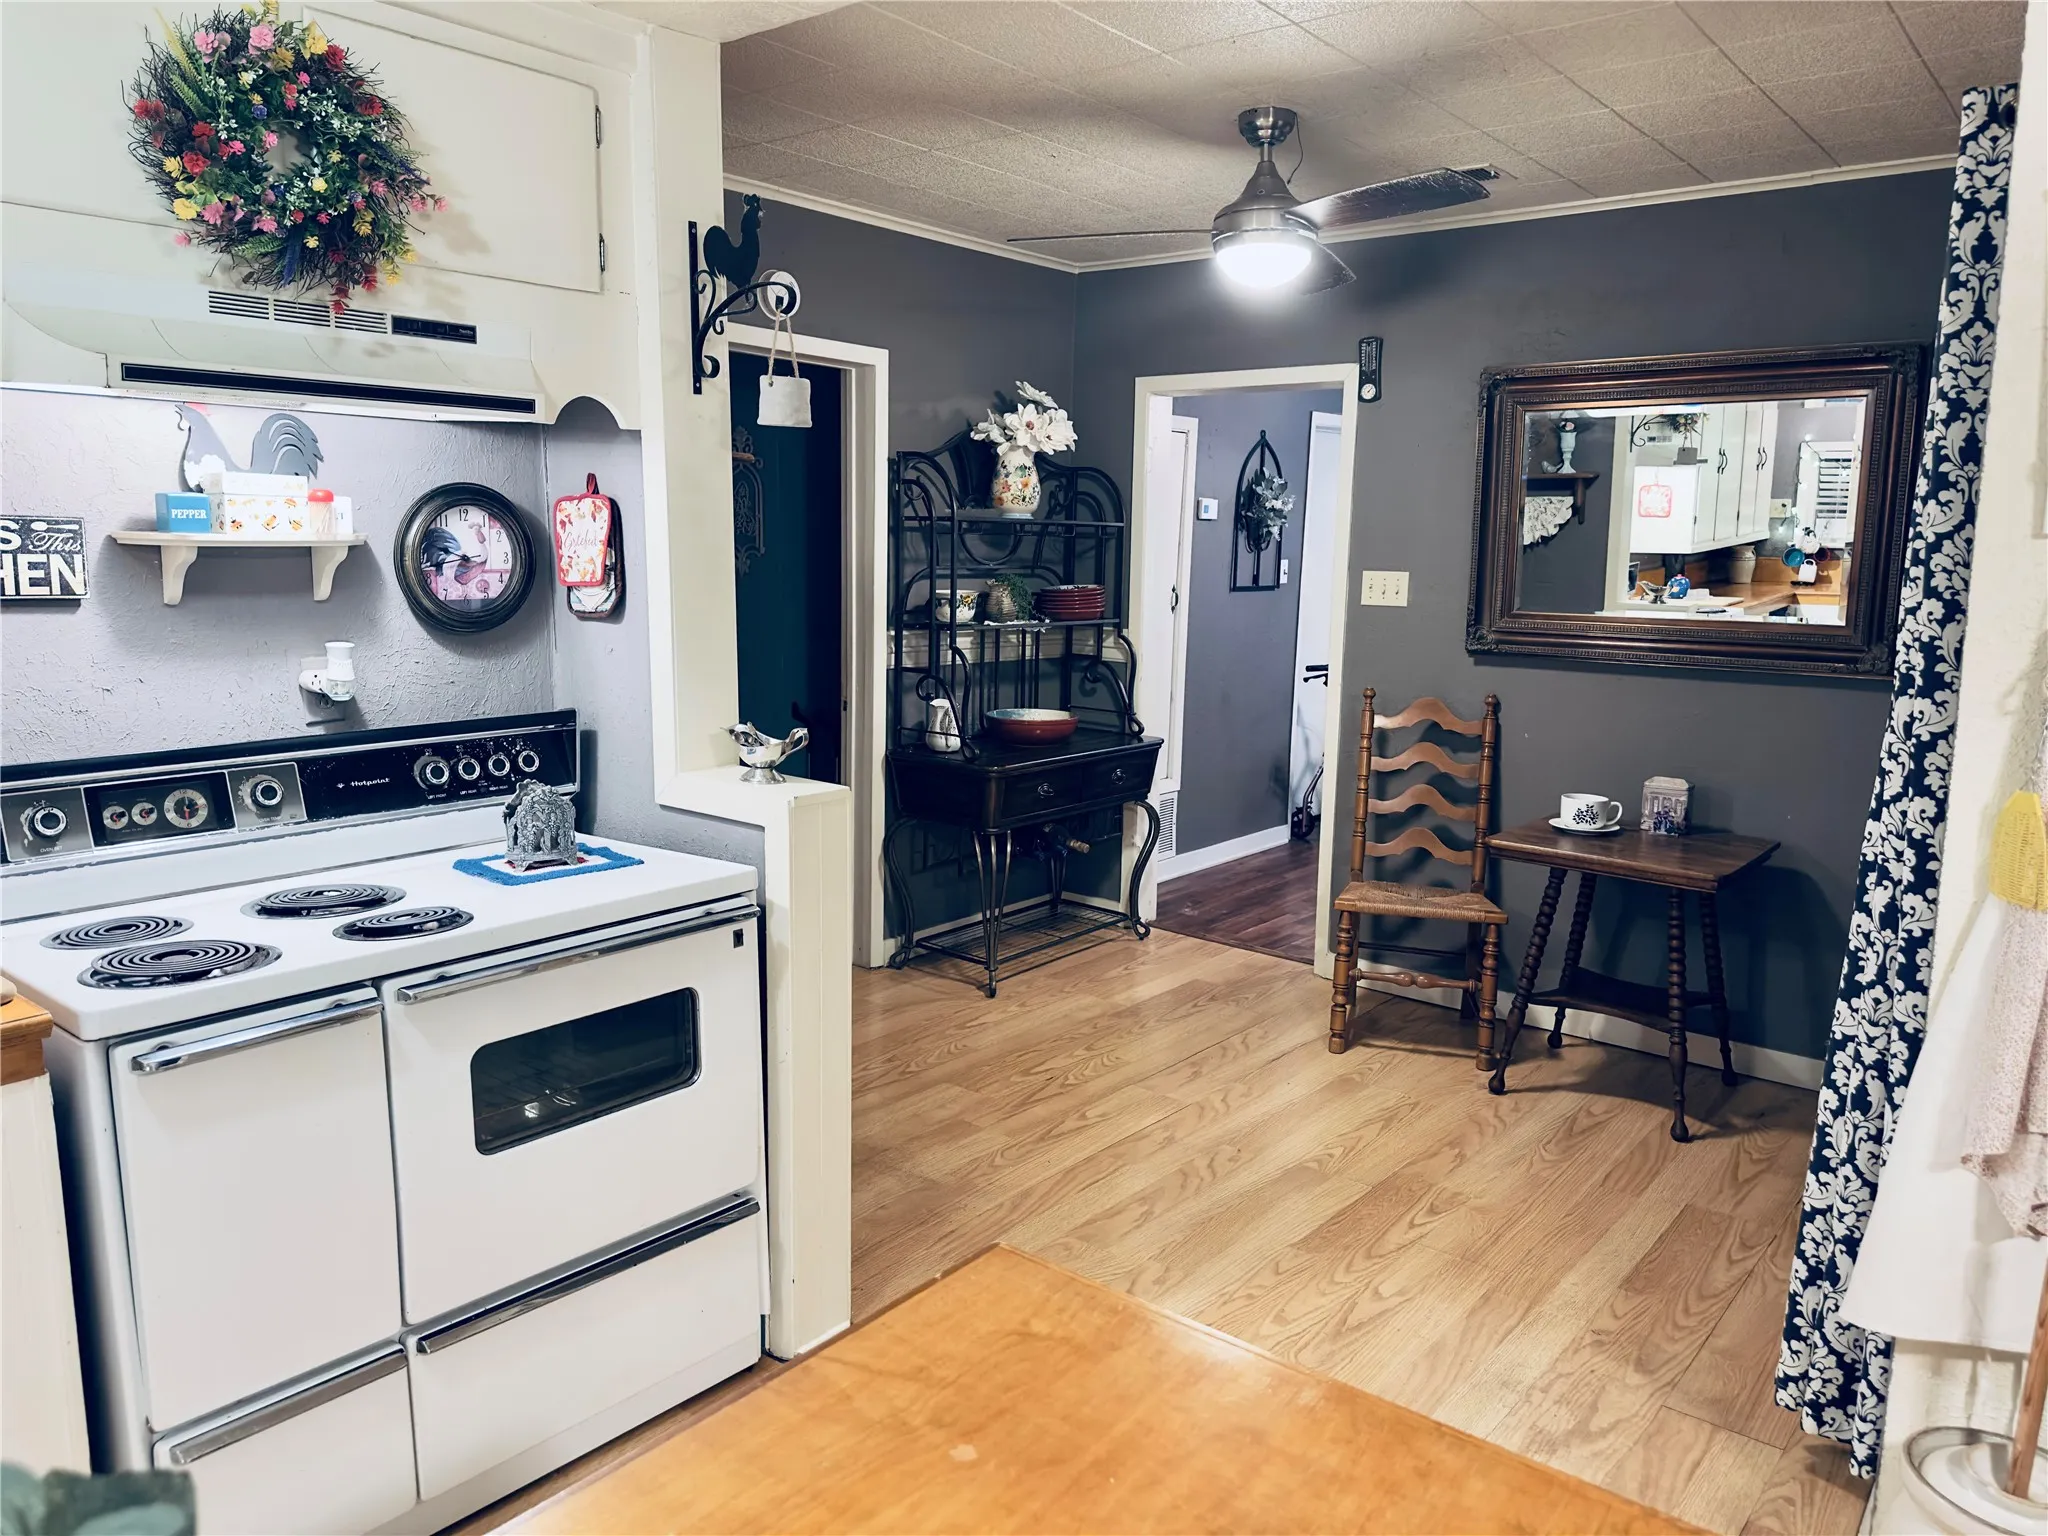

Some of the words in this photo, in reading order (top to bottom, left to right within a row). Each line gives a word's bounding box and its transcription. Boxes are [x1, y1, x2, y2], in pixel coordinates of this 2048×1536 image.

[171, 508, 207, 519] PEPPER
[459, 507, 469, 521] 12
[439, 514, 448, 527] 11
[482, 513, 487, 528] 1
[28, 531, 82, 551] This
[496, 529, 502, 543] 2
[503, 551, 509, 565] 3
[498, 572, 503, 585] 4
[443, 588, 448, 601] 7
[483, 587, 490, 600] 5
[350, 777, 391, 787] Hotpoint
